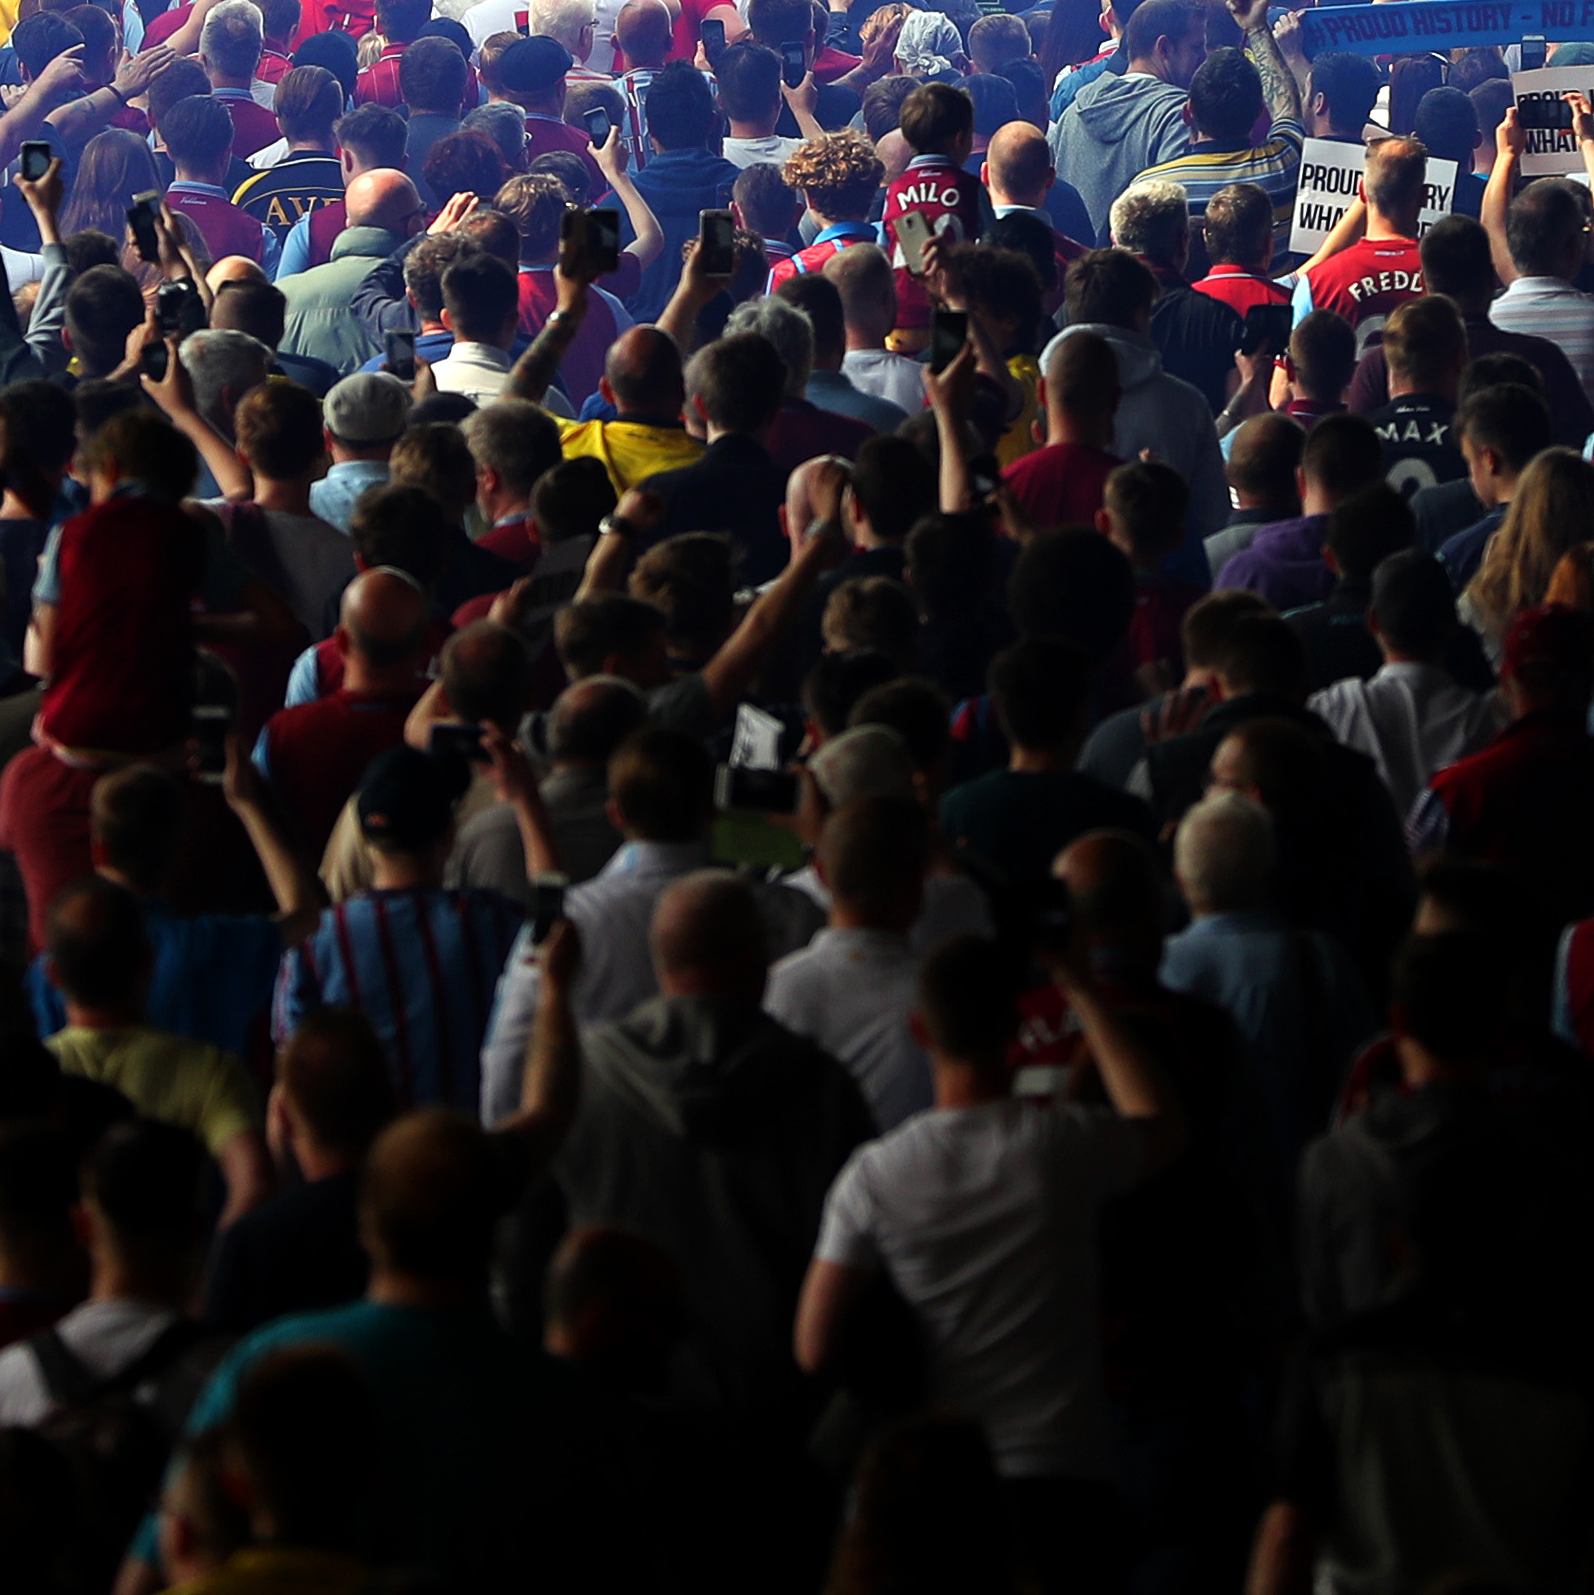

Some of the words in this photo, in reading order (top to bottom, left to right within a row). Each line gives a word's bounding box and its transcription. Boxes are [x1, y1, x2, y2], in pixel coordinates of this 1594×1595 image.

[1311, 12, 1407, 47] #PROUD
[1413, 3, 1513, 36] HISTORY
[1542, 2, 1577, 28] NO
[1301, 162, 1362, 196] PROUD
[897, 182, 960, 211] MILO
[1374, 418, 1451, 447] MAX
